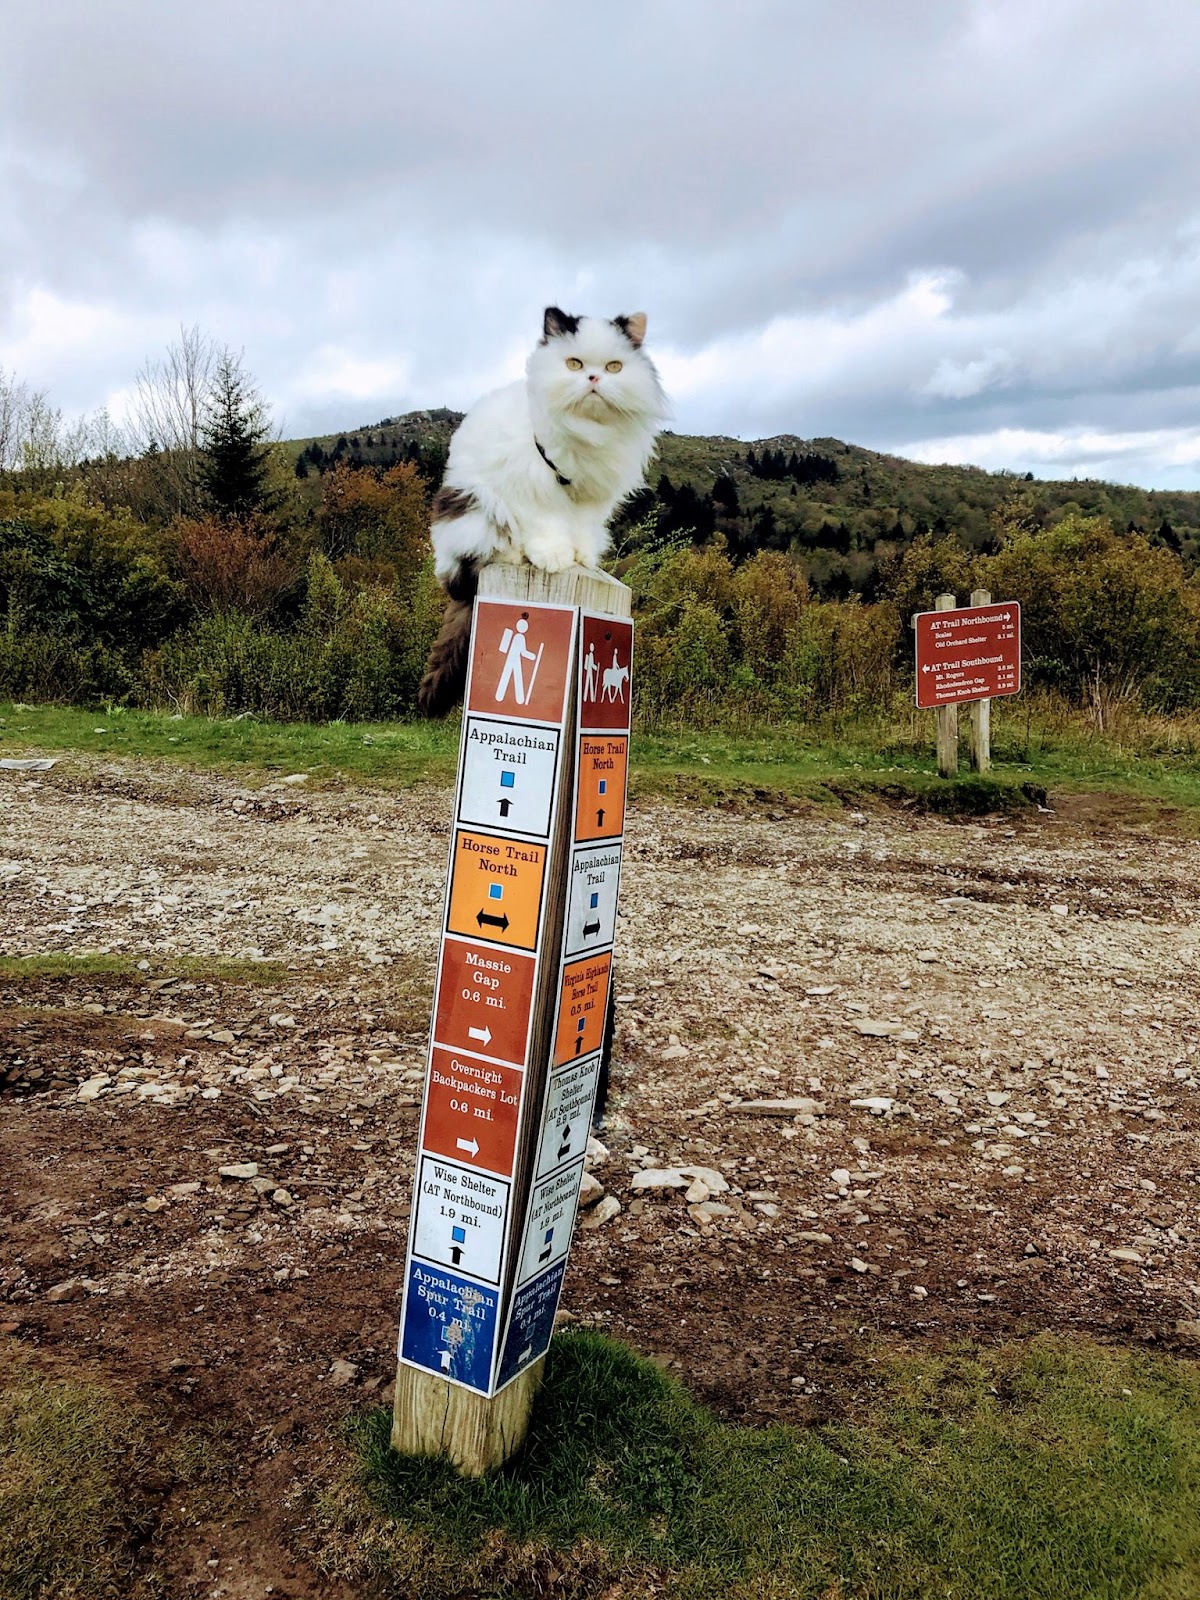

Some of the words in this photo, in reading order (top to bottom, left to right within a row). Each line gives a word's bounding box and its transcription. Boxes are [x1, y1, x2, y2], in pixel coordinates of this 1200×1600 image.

[930, 622, 941, 630] AT
[943, 619, 960, 628] Trail
[961, 614, 1003, 626] Northbound
[946, 638, 967, 647] Orchard
[931, 664, 941, 672] AT
[943, 661, 960, 670] Trail
[961, 655, 1003, 667] Southbound
[946, 672, 964, 680] Rogers
[972, 686, 990, 694] Shelter
[470, 728, 555, 751] Appalachian
[583, 743, 604, 754] Horse
[607, 743, 625, 754] Trail
[493, 749, 527, 764] Trail
[593, 758, 614, 769] North
[462, 838, 500, 855] Horse
[505, 846, 539, 863] Trail
[479, 859, 518, 876] North
[574, 854, 619, 872] Appalachian
[587, 872, 605, 885] Trail
[465, 952, 512, 974] Massie
[473, 971, 500, 990] Gap
[565, 970, 584, 988] Virginia
[585, 962, 608, 982] Highlands
[462, 989, 481, 1002] 0.6
[485, 995, 507, 1009] mi.
[572, 987, 586, 1000] Horse
[587, 981, 598, 996] Trail
[571, 1000, 582, 1016] 0.5
[584, 998, 595, 1012] mi.
[451, 1060, 502, 1084] Overnight
[554, 1072, 578, 1090] Thomas
[579, 1062, 595, 1078] Knob
[432, 1071, 496, 1099] Backpackers
[500, 1090, 518, 1106] Lot
[561, 1083, 583, 1101] Shelter
[450, 1099, 468, 1113] 0.6
[473, 1106, 494, 1121] mi.
[559, 1088, 594, 1115] Southbound)
[570, 1107, 581, 1120] mi.
[434, 1166, 458, 1184] Wise
[461, 1176, 496, 1197] Shelter
[540, 1185, 554, 1200] Wise
[556, 1172, 576, 1190] Shelter
[423, 1181, 440, 1197] (AT
[443, 1188, 502, 1218] Northbound)
[532, 1206, 543, 1222] (AT
[543, 1183, 578, 1214] Northbound)
[440, 1206, 456, 1219] 1.9
[461, 1214, 481, 1228] mi.
[552, 1207, 564, 1222] mi.
[413, 1268, 494, 1307] Appalachian
[515, 1267, 563, 1308] Appalachian
[538, 1282, 557, 1303] Trail
[418, 1285, 448, 1306] Spur
[453, 1298, 486, 1320] Trail
[428, 1307, 446, 1322] 0.4
